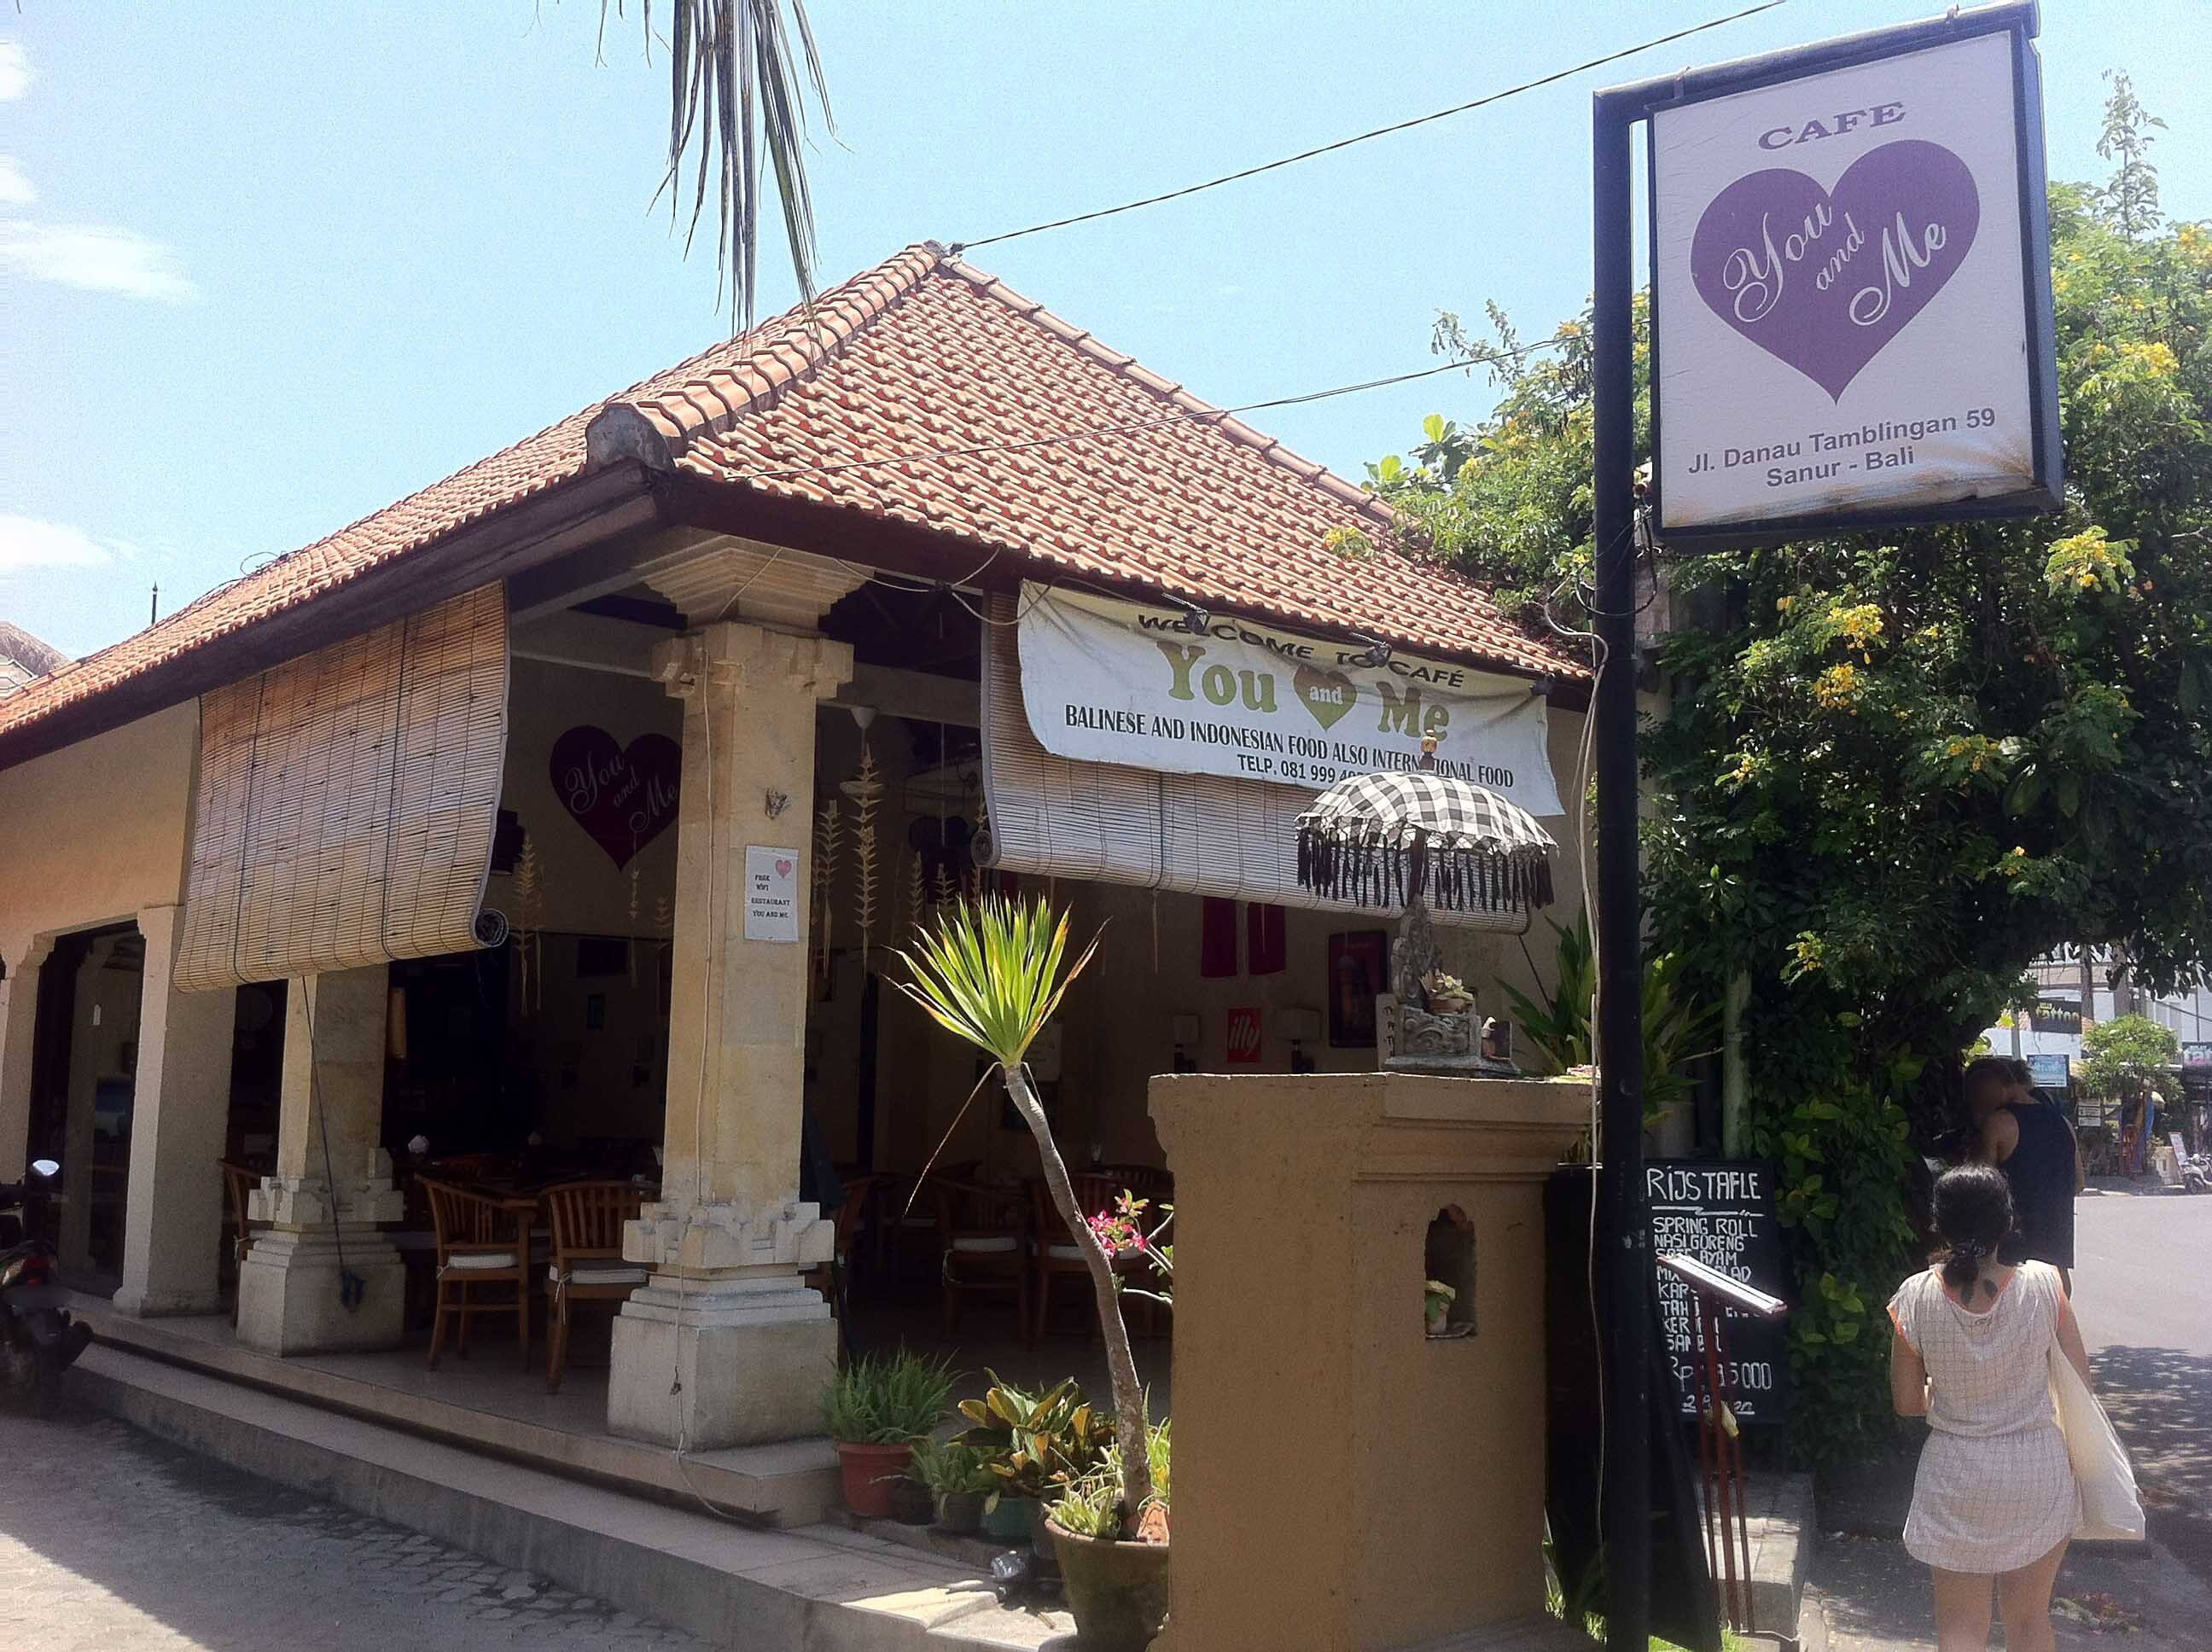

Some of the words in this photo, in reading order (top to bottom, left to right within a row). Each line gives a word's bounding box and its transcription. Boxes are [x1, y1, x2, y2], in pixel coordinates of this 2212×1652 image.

[1758, 102, 1906, 150] CAFE
[1723, 203, 1832, 323] You
[1816, 212, 1866, 291] and
[1848, 212, 1947, 326] Me
[1688, 454, 1715, 474] Jl.
[1723, 441, 1802, 468] Danau
[1808, 415, 1957, 453] Tamblingan
[1965, 407, 1996, 428] 59
[1767, 460, 1841, 487] Sanur
[1866, 446, 1914, 471] Bali
[1138, 614, 1315, 660] WECOME
[1388, 660, 1465, 688] CAFÉ
[1156, 641, 1278, 713] You
[1308, 685, 1344, 706] and
[1376, 681, 1450, 742] Me
[1065, 704, 1147, 736] BALINESE
[1151, 715, 1185, 740] AND
[1190, 721, 1284, 753] INDONESIAN
[1288, 735, 1328, 759] FOOD
[1331, 742, 1368, 766] ALSO
[1478, 765, 1514, 788] FOOD
[1237, 753, 1278, 776] TELP.
[1280, 759, 1307, 780] 081
[1310, 764, 1336, 784] 999
[565, 750, 626, 814] You
[613, 765, 640, 808] and
[629, 771, 678, 834] Me
[1229, 1014, 1260, 1056] illy
[1652, 1216, 1708, 1236] SPRING
[1715, 1218, 1759, 1238] ROLL
[1654, 1234, 1687, 1248] NASI
